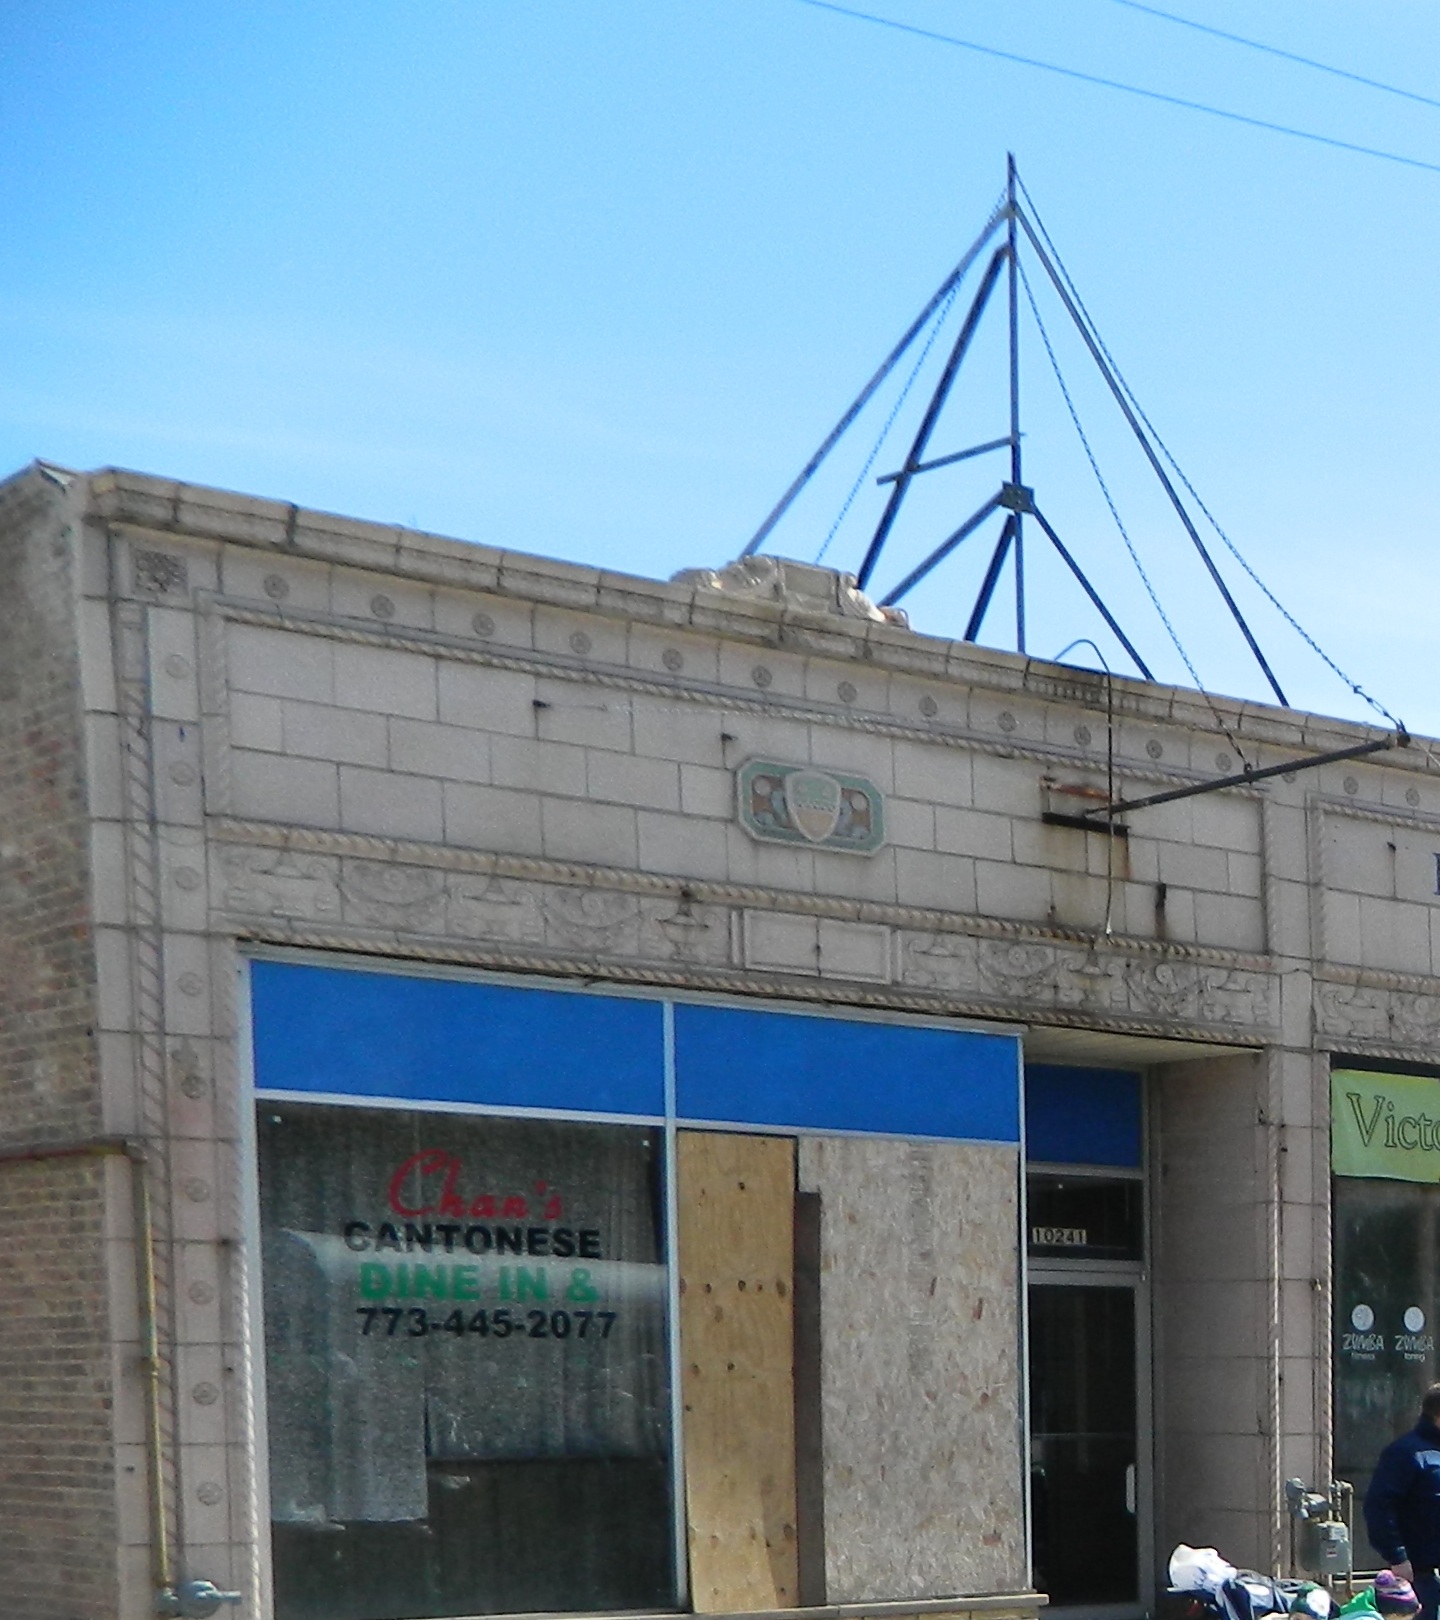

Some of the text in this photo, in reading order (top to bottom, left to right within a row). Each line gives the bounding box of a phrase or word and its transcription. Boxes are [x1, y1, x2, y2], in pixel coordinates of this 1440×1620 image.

[388, 1148, 564, 1219] Chan's
[343, 1220, 602, 1258] CANTONESE
[1035, 1228, 1083, 1244] 10241
[360, 1262, 600, 1303] DINE IN &
[356, 1307, 618, 1340] 773-445-2077
